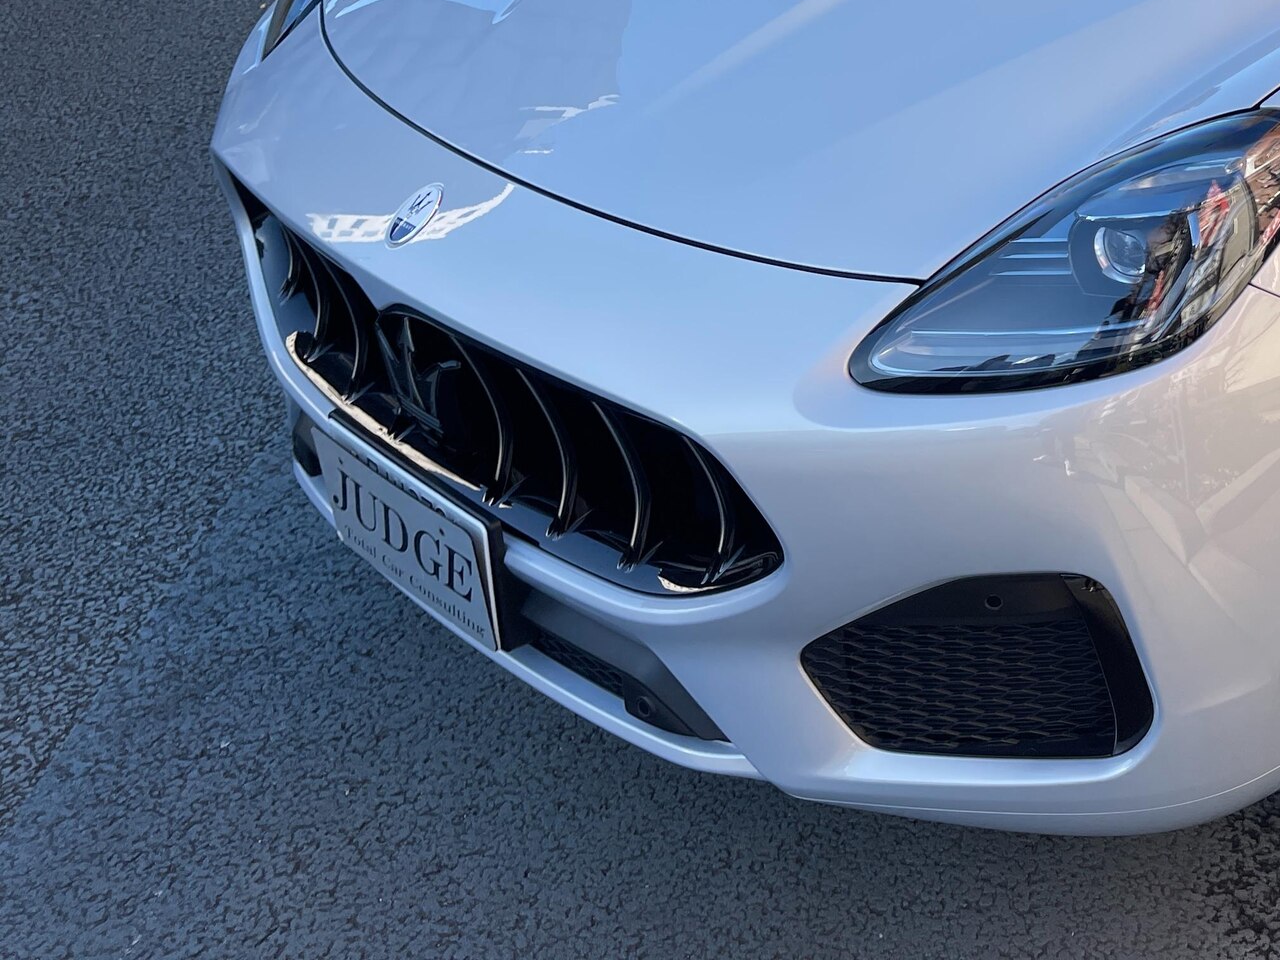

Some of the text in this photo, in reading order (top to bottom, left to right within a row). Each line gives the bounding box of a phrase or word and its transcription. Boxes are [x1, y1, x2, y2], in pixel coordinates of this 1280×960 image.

[333, 467, 473, 603] JUDGE
[344, 524, 377, 559] Total
[382, 553, 405, 577] Car
